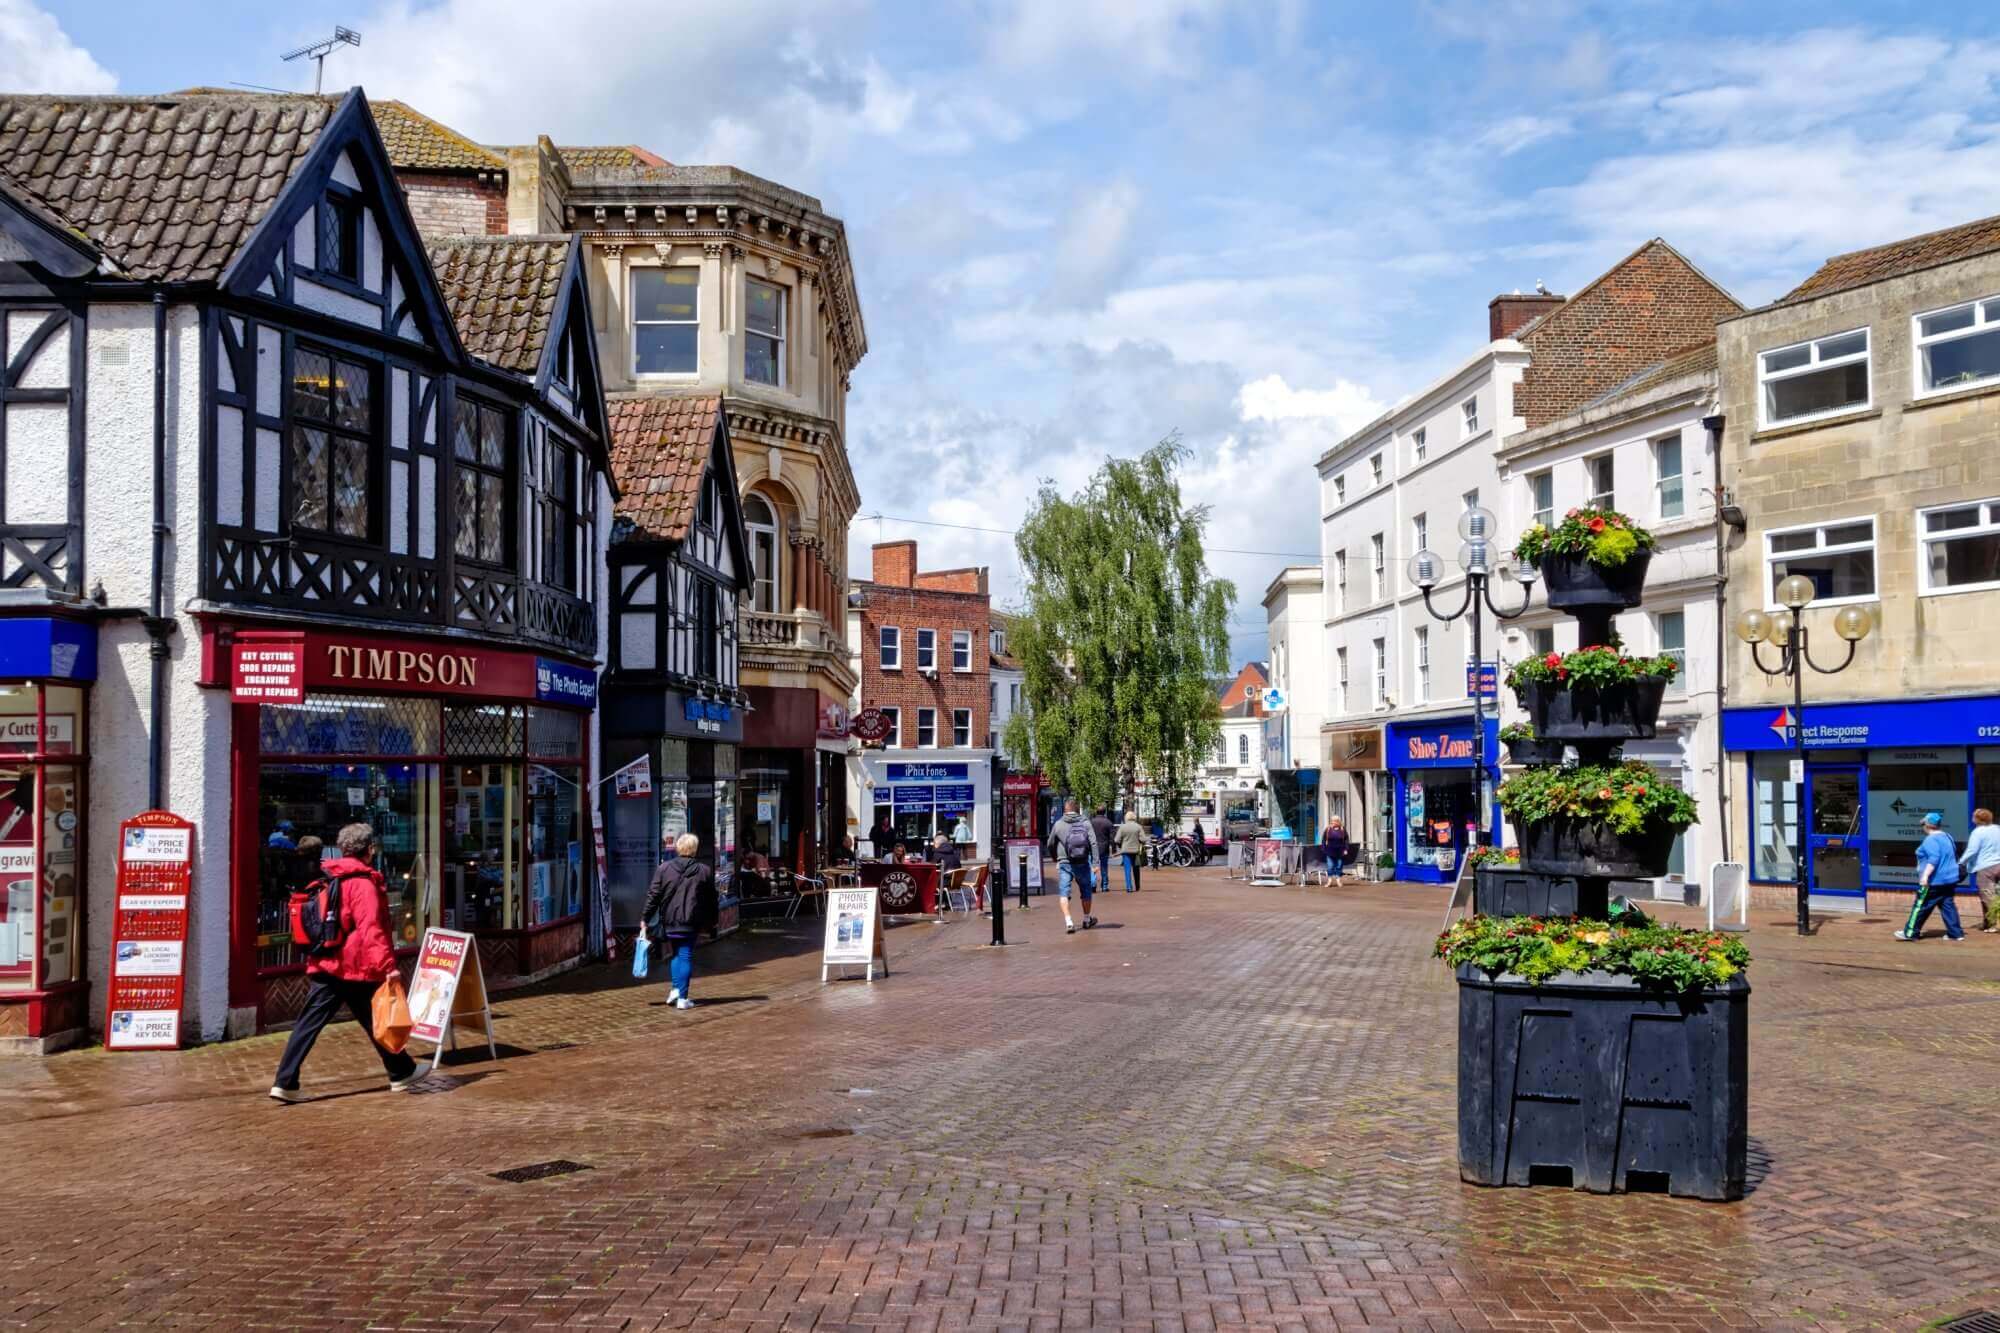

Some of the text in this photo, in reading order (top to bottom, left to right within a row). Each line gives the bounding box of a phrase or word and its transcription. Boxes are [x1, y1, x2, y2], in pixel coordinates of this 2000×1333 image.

[241, 651, 295, 661] KEY CUTTING
[239, 663, 296, 673] SHOE REPAIRS
[327, 645, 477, 686] TIMPSON
[244, 675, 290, 685] ENGRAVING
[1468, 672, 1495, 682] Soe
[552, 672, 563, 692] The
[563, 676, 579, 695] Photo
[579, 679, 595, 701] Expert
[1468, 683, 1496, 692] Zne
[236, 687, 299, 697] WATCH REPAIRS
[1788, 725, 1869, 739] Dect Response
[1409, 734, 1473, 759] Shoe Zone
[905, 763, 947, 777] iPhix Fones
[137, 814, 178, 824] TIMPSON
[158, 839, 185, 847] PRICE
[884, 873, 912, 884] COSTA
[838, 892, 869, 902] PHONE
[883, 892, 914, 905] COFFEE
[838, 902, 869, 910] REPAIRS
[439, 940, 464, 955] PRICE
[146, 1023, 173, 1031] PRICE
